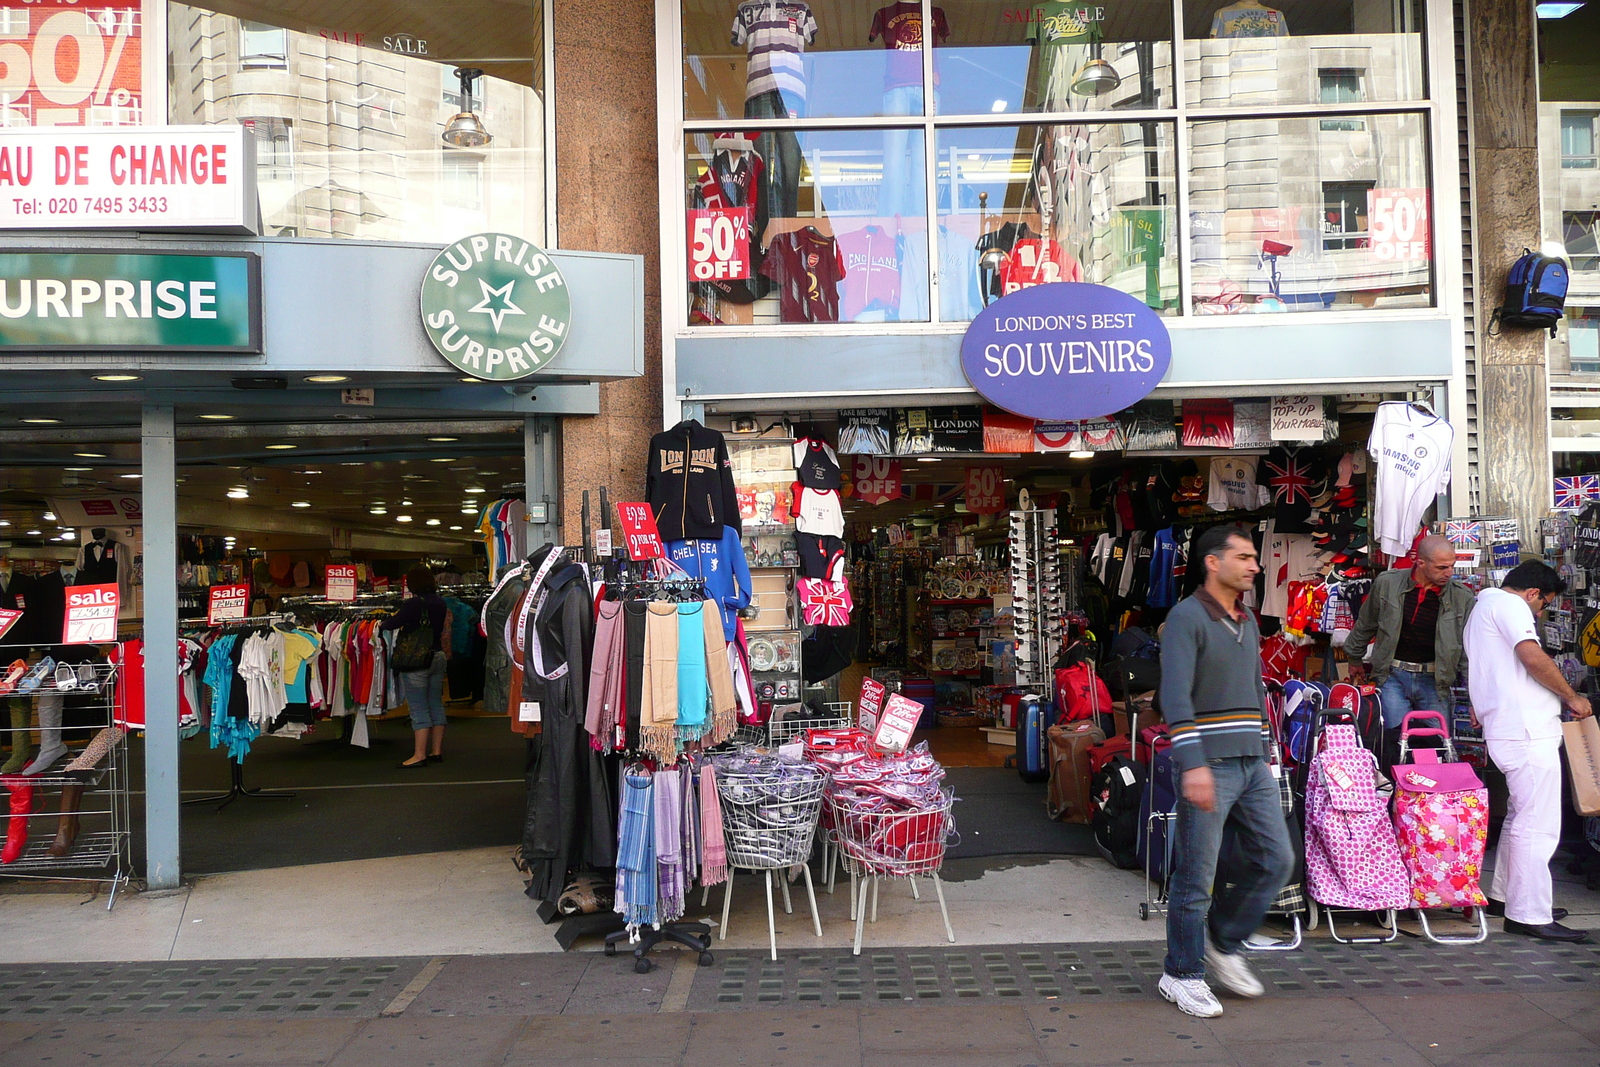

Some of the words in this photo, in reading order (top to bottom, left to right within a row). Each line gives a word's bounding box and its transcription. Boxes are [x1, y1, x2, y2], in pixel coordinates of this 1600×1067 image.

[1003, 8, 1046, 23] SALE
[1062, 6, 1105, 22] SALE
[318, 28, 366, 47] SALE
[383, 36, 428, 55] SALE
[54, 145, 89, 185] DE
[109, 144, 227, 186] CHANGE
[12, 198, 43, 214] Tel:
[48, 198, 78, 214] 020
[84, 197, 123, 213] 7495
[129, 196, 168, 213] 3433
[1374, 196, 1427, 242] 50%
[692, 215, 745, 262] 50%
[1374, 241, 1424, 260] OFF
[432, 235, 563, 294] SUPRISE
[694, 260, 742, 279] OFF
[848, 253, 898, 271] ENGLAND
[1018, 244, 1062, 282] 1/2
[995, 315, 1087, 332] LONDON'S
[1091, 313, 1136, 329] BEST
[427, 309, 566, 373] SURPRISE
[984, 338, 1154, 378] SOUVENIRS
[1272, 405, 1316, 417] TOP-UP
[933, 418, 980, 429] LONDON
[1272, 417, 1298, 431] YOUR
[660, 448, 718, 472] LONDON
[856, 479, 896, 494] OFF
[969, 468, 1003, 497] 50%
[970, 496, 1000, 508] OFF
[630, 534, 642, 557] 2
[673, 542, 718, 560] CHELSEA
[547, 548, 561, 563] SALE
[1494, 551, 1517, 560] London
[327, 567, 354, 577] sale
[534, 568, 546, 586] SALE
[69, 589, 117, 606] sale
[212, 586, 246, 599] sale
[525, 588, 536, 605] SALE
[1587, 599, 1597, 608] NO
[519, 613, 527, 629] SALE
[890, 697, 923, 713] Special
[892, 707, 916, 719] Offer
